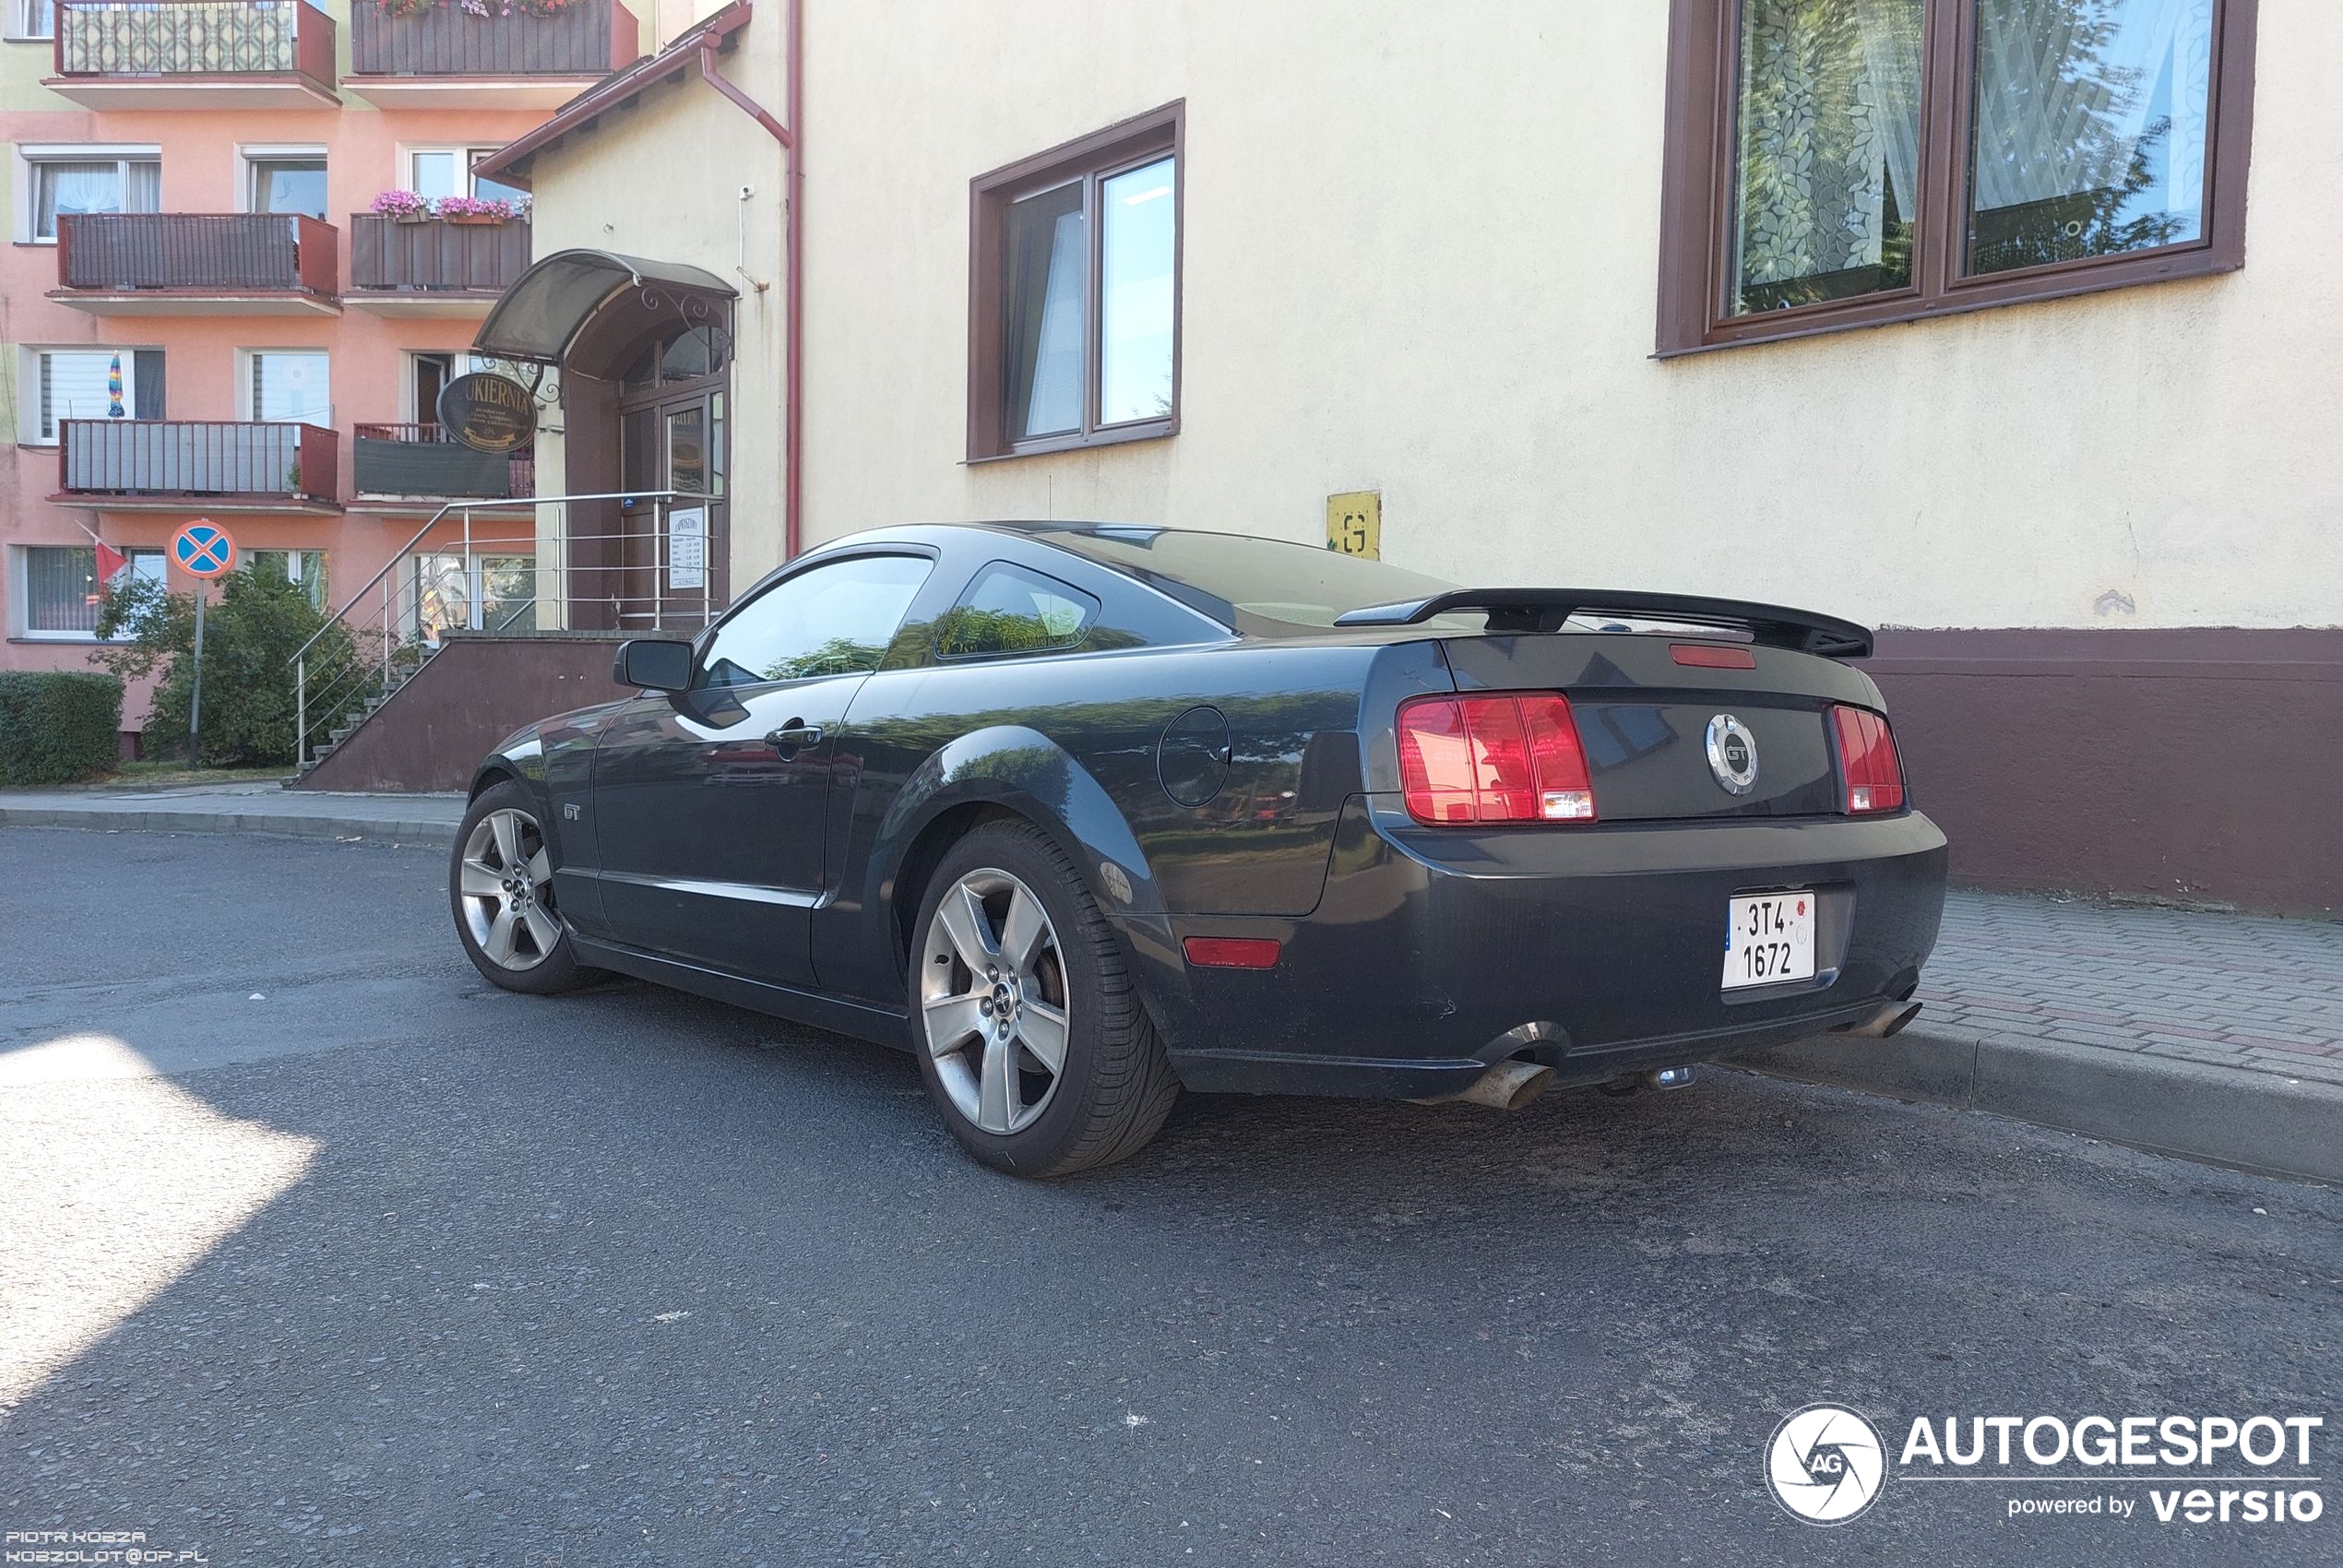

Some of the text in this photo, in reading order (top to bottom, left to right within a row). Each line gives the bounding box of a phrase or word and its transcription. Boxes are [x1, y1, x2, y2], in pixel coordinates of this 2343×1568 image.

[458, 377, 529, 415] UKIERNIA
[1344, 514, 1365, 552] G
[1726, 745, 1746, 761] GT
[564, 803, 580, 821] GT
[1748, 901, 1785, 936] 3T4
[1743, 943, 1791, 979] 1672
